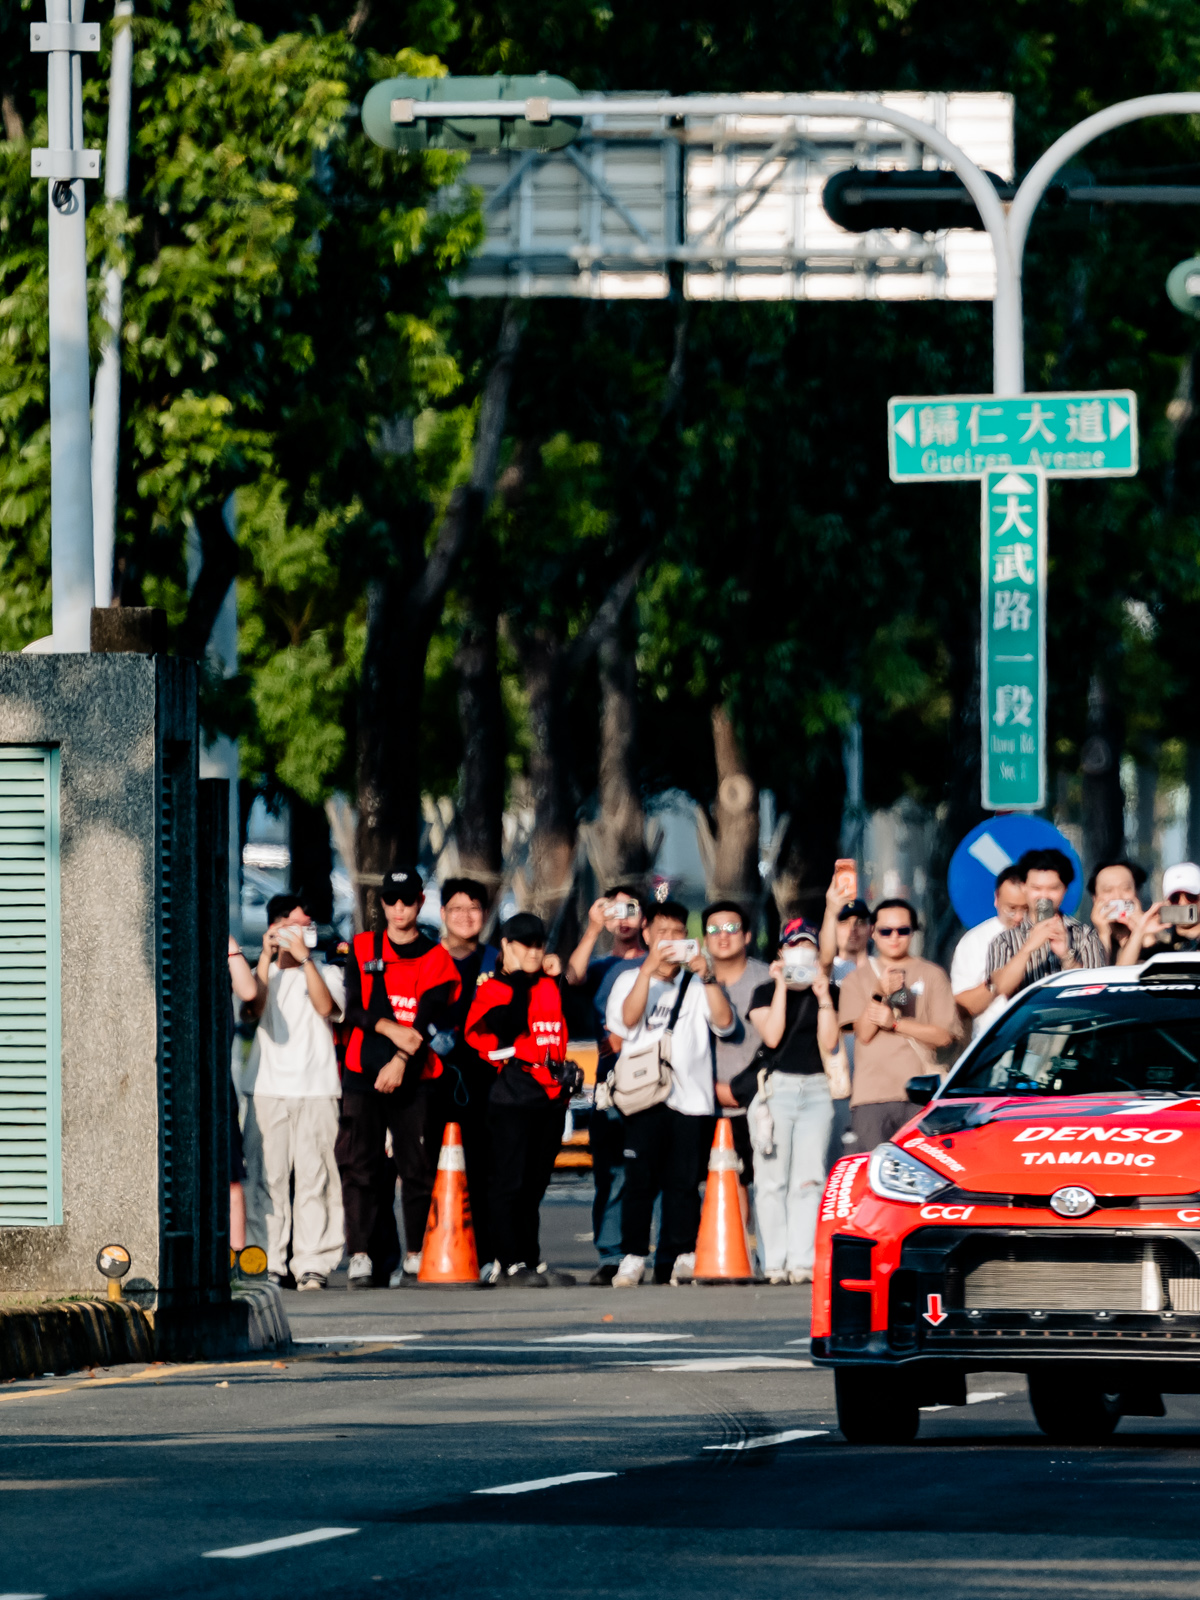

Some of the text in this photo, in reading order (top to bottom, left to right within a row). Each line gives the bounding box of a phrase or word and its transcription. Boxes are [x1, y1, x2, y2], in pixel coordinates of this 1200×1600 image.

[918, 400, 1108, 449] 歸仁大道
[921, 447, 1106, 473] Gueiren Avenue
[991, 495, 1035, 728] 大武路一段
[1107, 984, 1196, 993] TOYOTA
[1012, 1127, 1184, 1144] DENSO
[1021, 1151, 1156, 1168] TAMADIC
